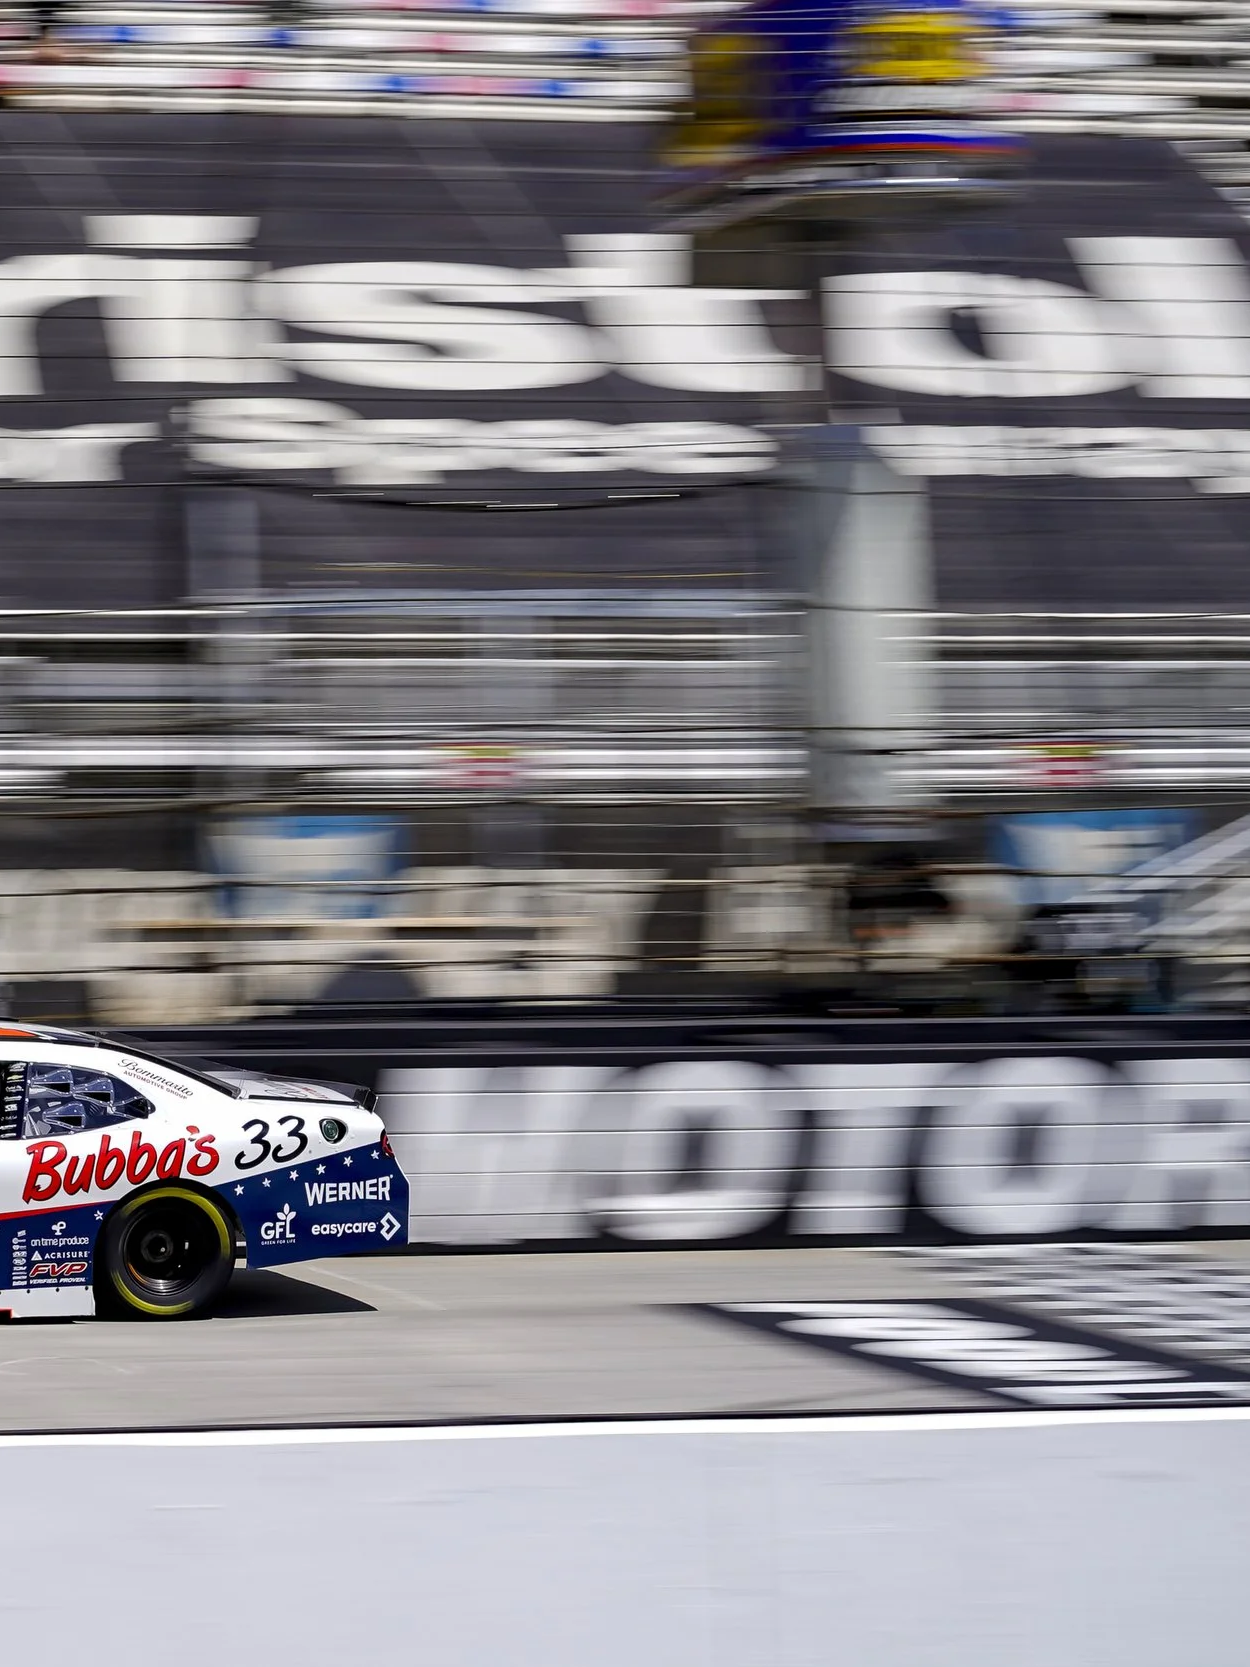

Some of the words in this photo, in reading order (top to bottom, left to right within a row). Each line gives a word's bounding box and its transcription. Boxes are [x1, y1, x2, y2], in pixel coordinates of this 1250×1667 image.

[117, 1058, 194, 1097] Bommarito
[123, 1070, 164, 1090] AUTOMOTIVE
[165, 1087, 188, 1100] GROUP
[234, 1115, 308, 1170] 33
[380, 1057, 1250, 1244] MOTOR
[21, 1125, 220, 1204] Bubba's
[304, 1175, 391, 1207] WERNER
[30, 1239, 41, 1247] on
[41, 1237, 58, 1246] time
[58, 1236, 90, 1247] produce
[260, 1217, 296, 1240] GFL
[311, 1221, 377, 1238] easycare
[29, 1262, 88, 1277] FVP
[44, 1251, 88, 1260] ACRISURE
